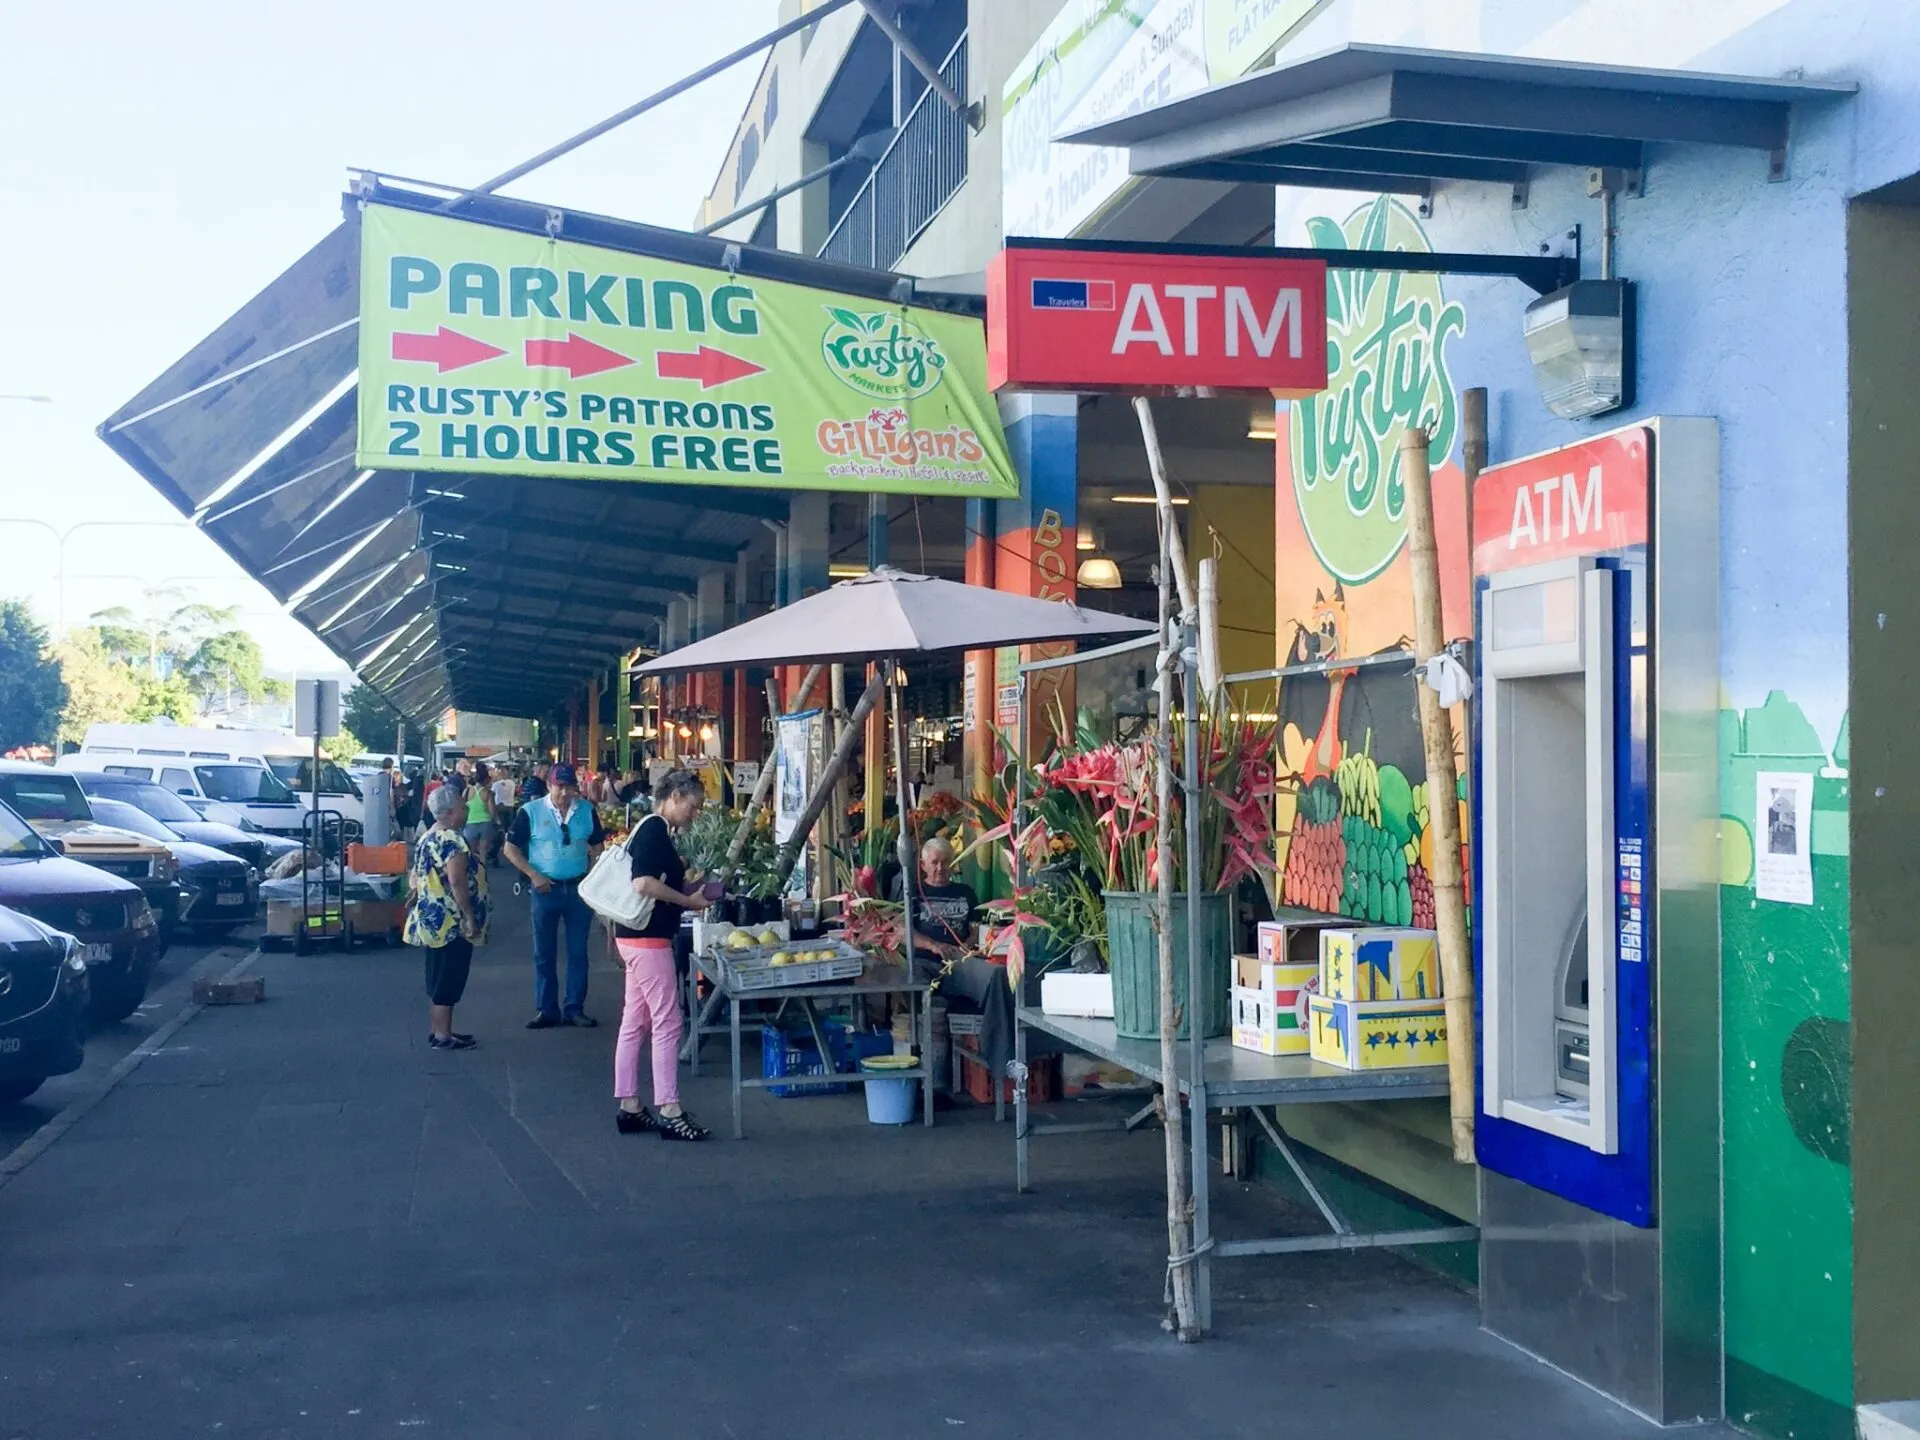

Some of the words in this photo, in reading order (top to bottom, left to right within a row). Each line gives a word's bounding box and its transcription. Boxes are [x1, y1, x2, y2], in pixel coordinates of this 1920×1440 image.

[1091, 62, 1137, 120] Saturday
[1139, 45, 1148, 76] &
[1150, 0, 1196, 63] Sunday
[1045, 185, 1055, 231] 2
[1058, 145, 1109, 218] hours
[389, 255, 760, 336] PARKING
[1048, 296, 1085, 308] Travelex
[1111, 283, 1303, 358] ATM
[388, 384, 567, 419] RUSTY'S
[580, 394, 774, 432] PATRONS
[848, 372, 909, 395] MARKETS
[388, 420, 421, 457] 2
[440, 422, 636, 466] HOURS
[651, 433, 783, 474] FREE
[828, 460, 904, 479] Backpackers
[908, 466, 938, 480] Hotel
[955, 469, 990, 483] Resort
[1508, 464, 1603, 551] ATM
[737, 773, 745, 788] 2
